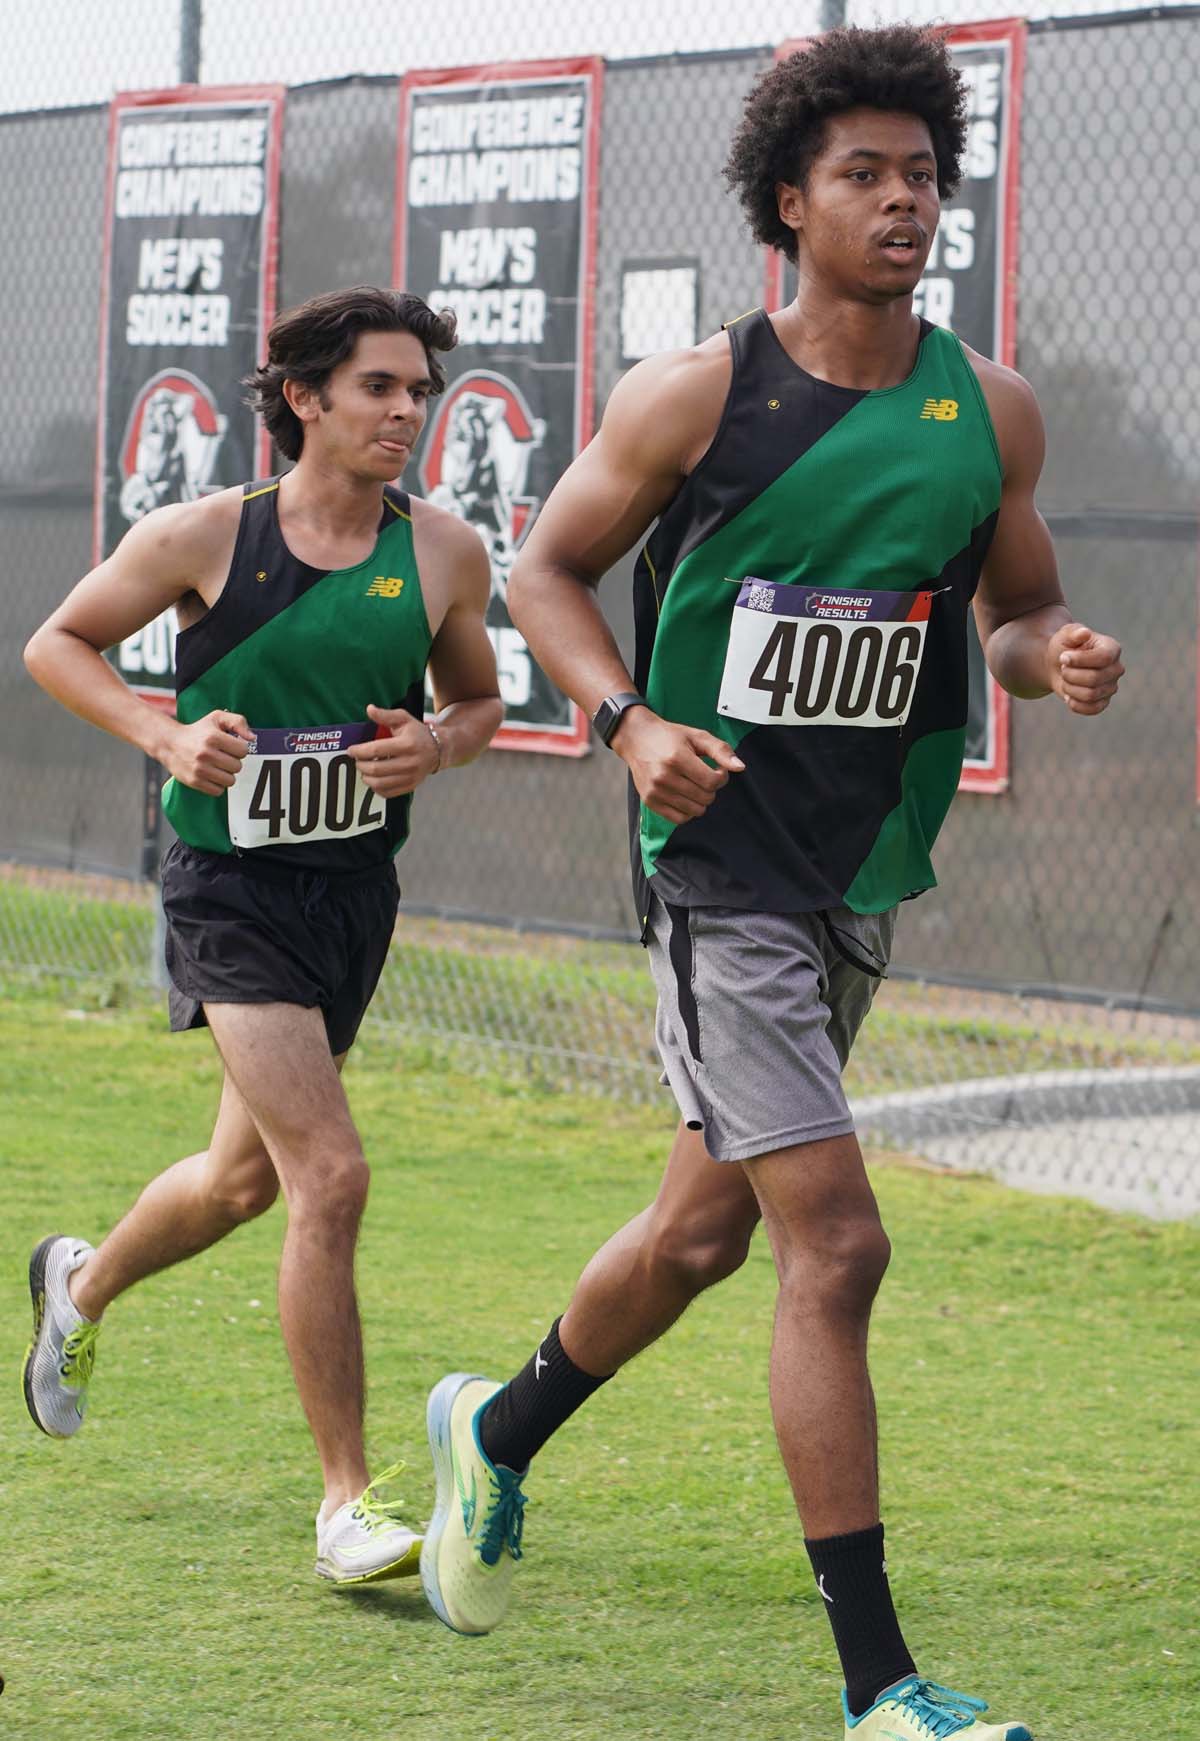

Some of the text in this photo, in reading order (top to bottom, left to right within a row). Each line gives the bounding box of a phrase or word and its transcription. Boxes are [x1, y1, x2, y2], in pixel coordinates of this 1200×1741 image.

[120, 119, 267, 167] CONFERENCE
[411, 96, 583, 151] CONFERENCE
[116, 166, 264, 218] CHAMPIONS
[408, 148, 580, 207] CHAMPIONS
[138, 238, 224, 290] MEN'S
[439, 227, 536, 286] MEN'S
[126, 294, 230, 346] SOCCER
[816, 607, 867, 619] RESULTS
[820, 595, 872, 607] FINISHED
[119, 605, 177, 675] 20
[749, 621, 921, 719] 4006
[295, 741, 340, 753] RESULTS
[297, 730, 342, 742] FINISHED
